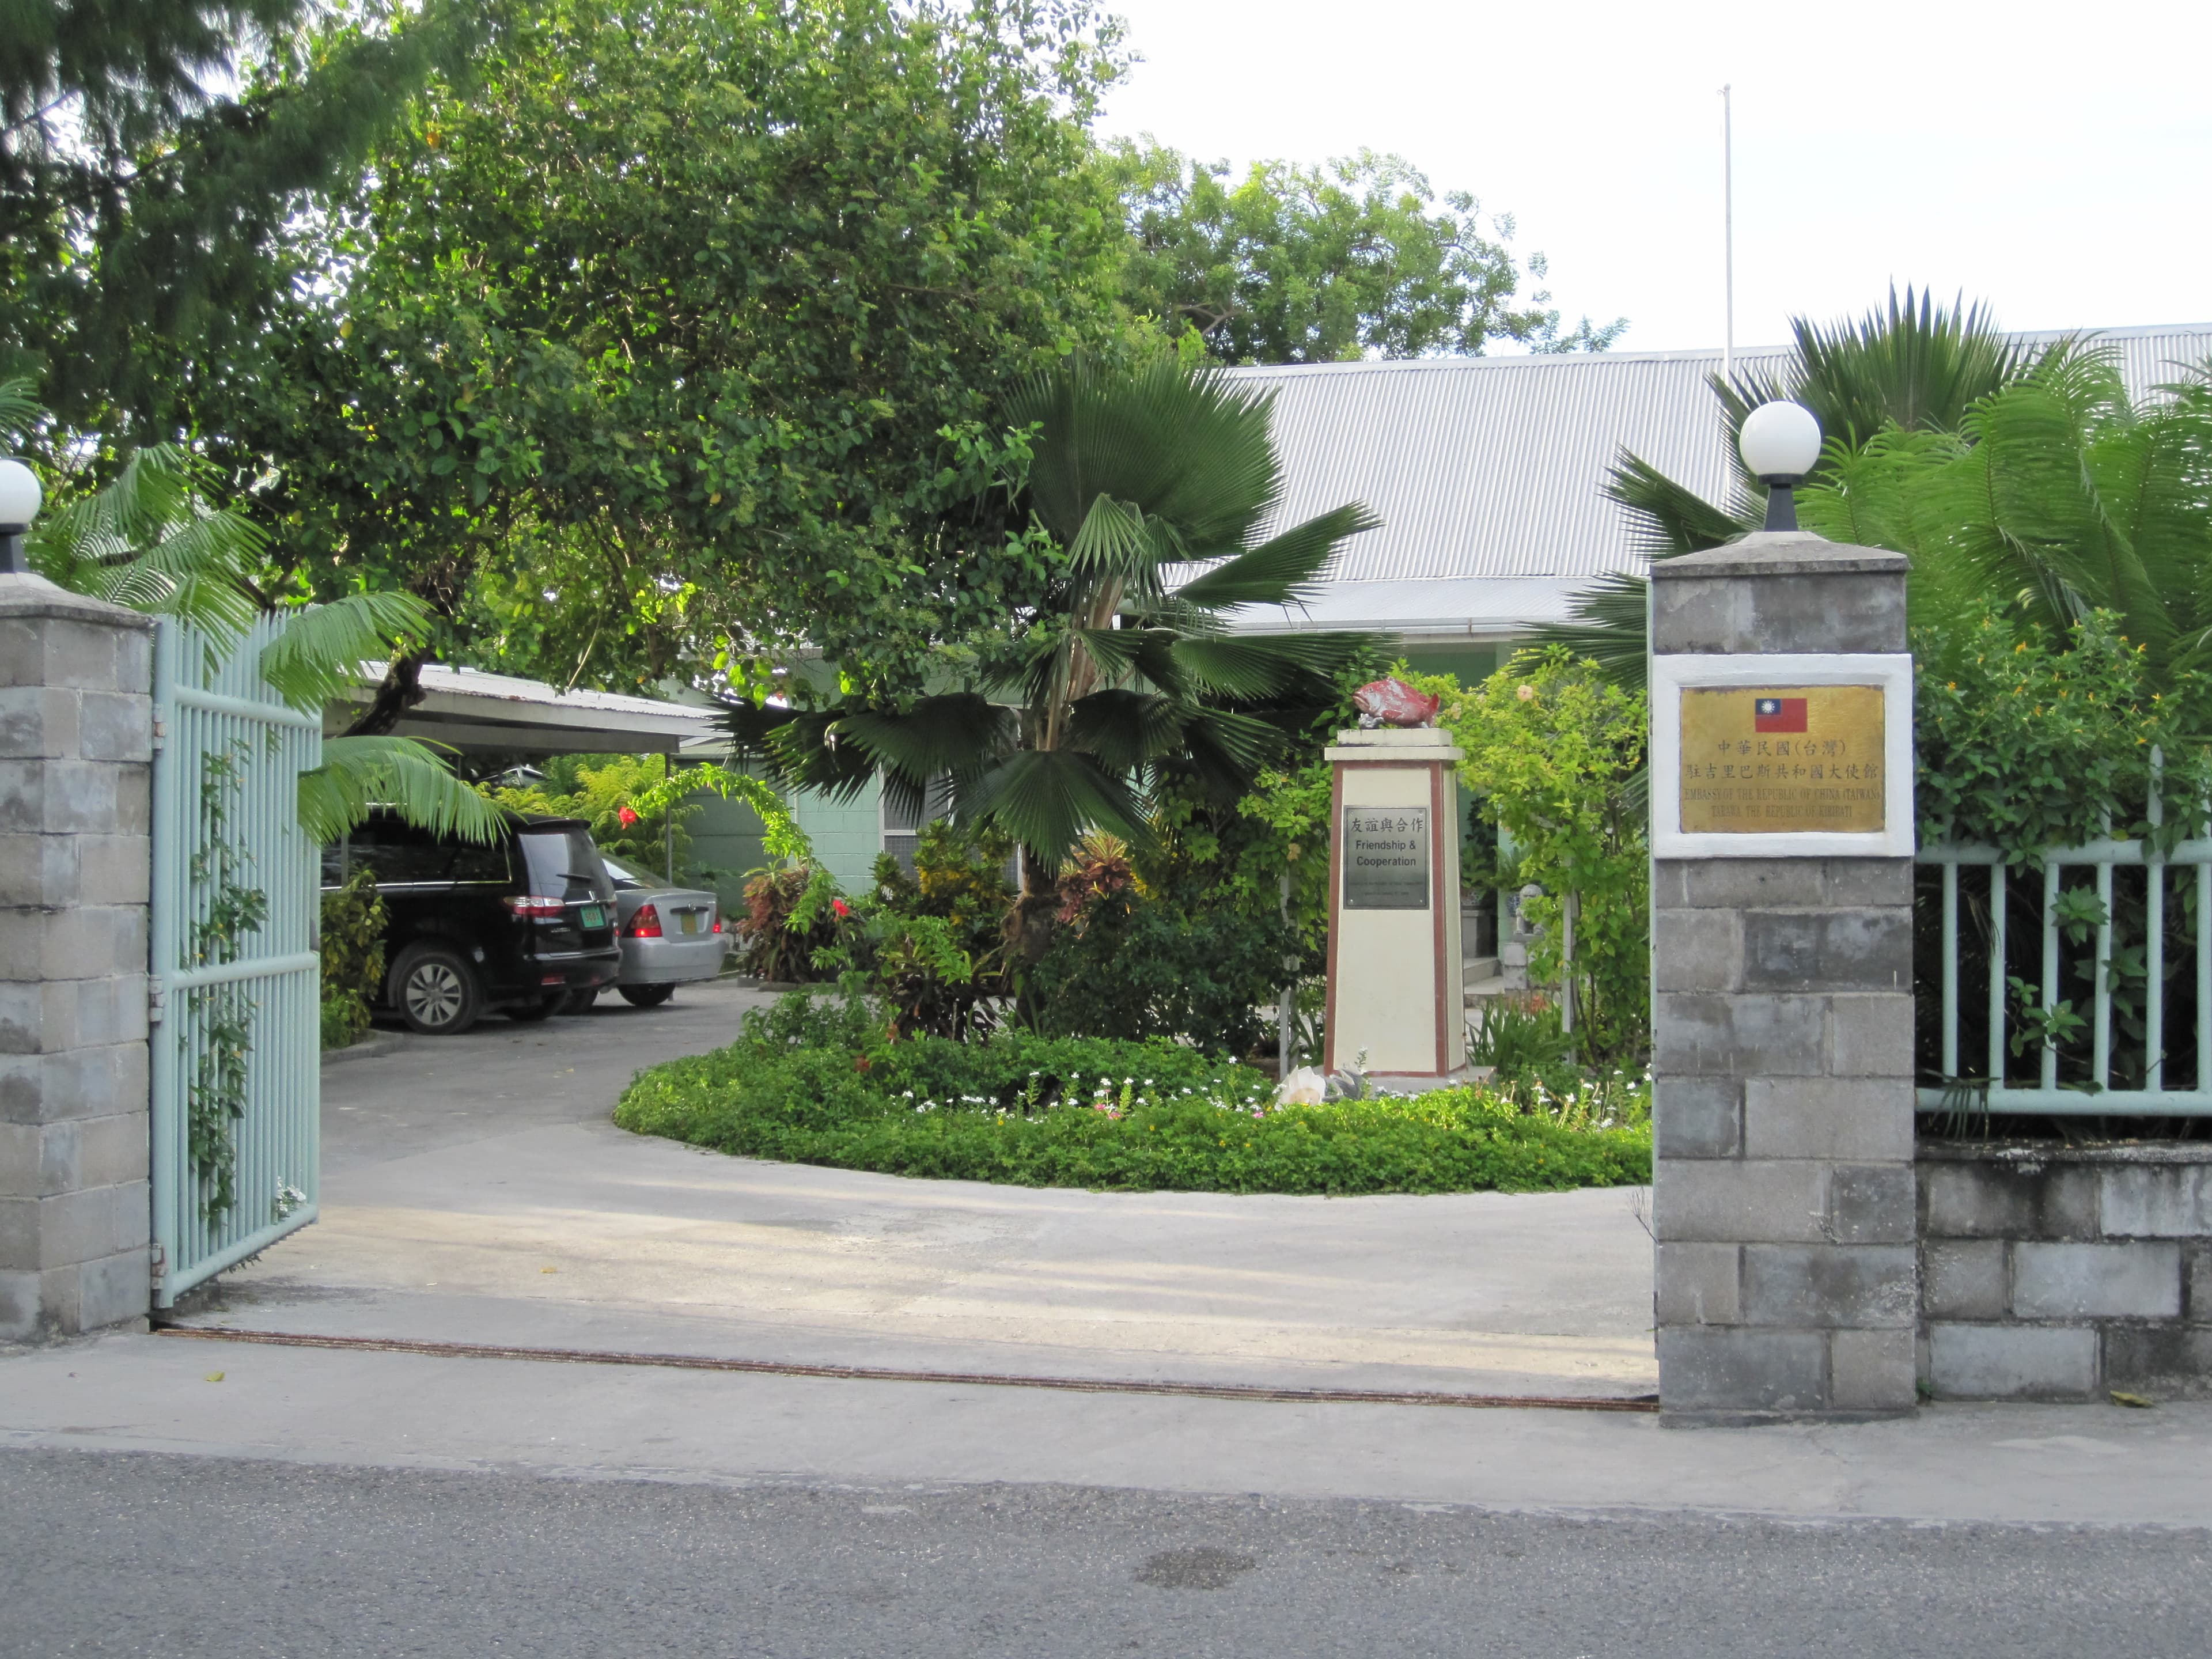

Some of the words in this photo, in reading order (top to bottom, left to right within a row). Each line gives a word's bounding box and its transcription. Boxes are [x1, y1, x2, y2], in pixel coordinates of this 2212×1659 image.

[1685, 763, 1878, 780] 駐吉里巴斯共和國大使館
[1684, 788, 1721, 800] EMBASSY
[1723, 788, 1734, 800] OF
[1737, 788, 1753, 800] THE
[1757, 788, 1796, 800] REPUBLIC
[1800, 788, 1811, 800] OF
[1815, 788, 1840, 800] CHINA
[1843, 788, 1880, 801] (TAIWAN)
[1746, 805, 1761, 817] THE
[1766, 805, 1802, 817] REPUBLIC
[1806, 805, 1816, 817] OF
[1819, 805, 1853, 817] KIRIBATI
[1351, 817, 1424, 833] 友誼與合作
[1356, 840, 1406, 851] Friendship
[1409, 840, 1416, 850] &
[1357, 856, 1416, 868] Cooperation
